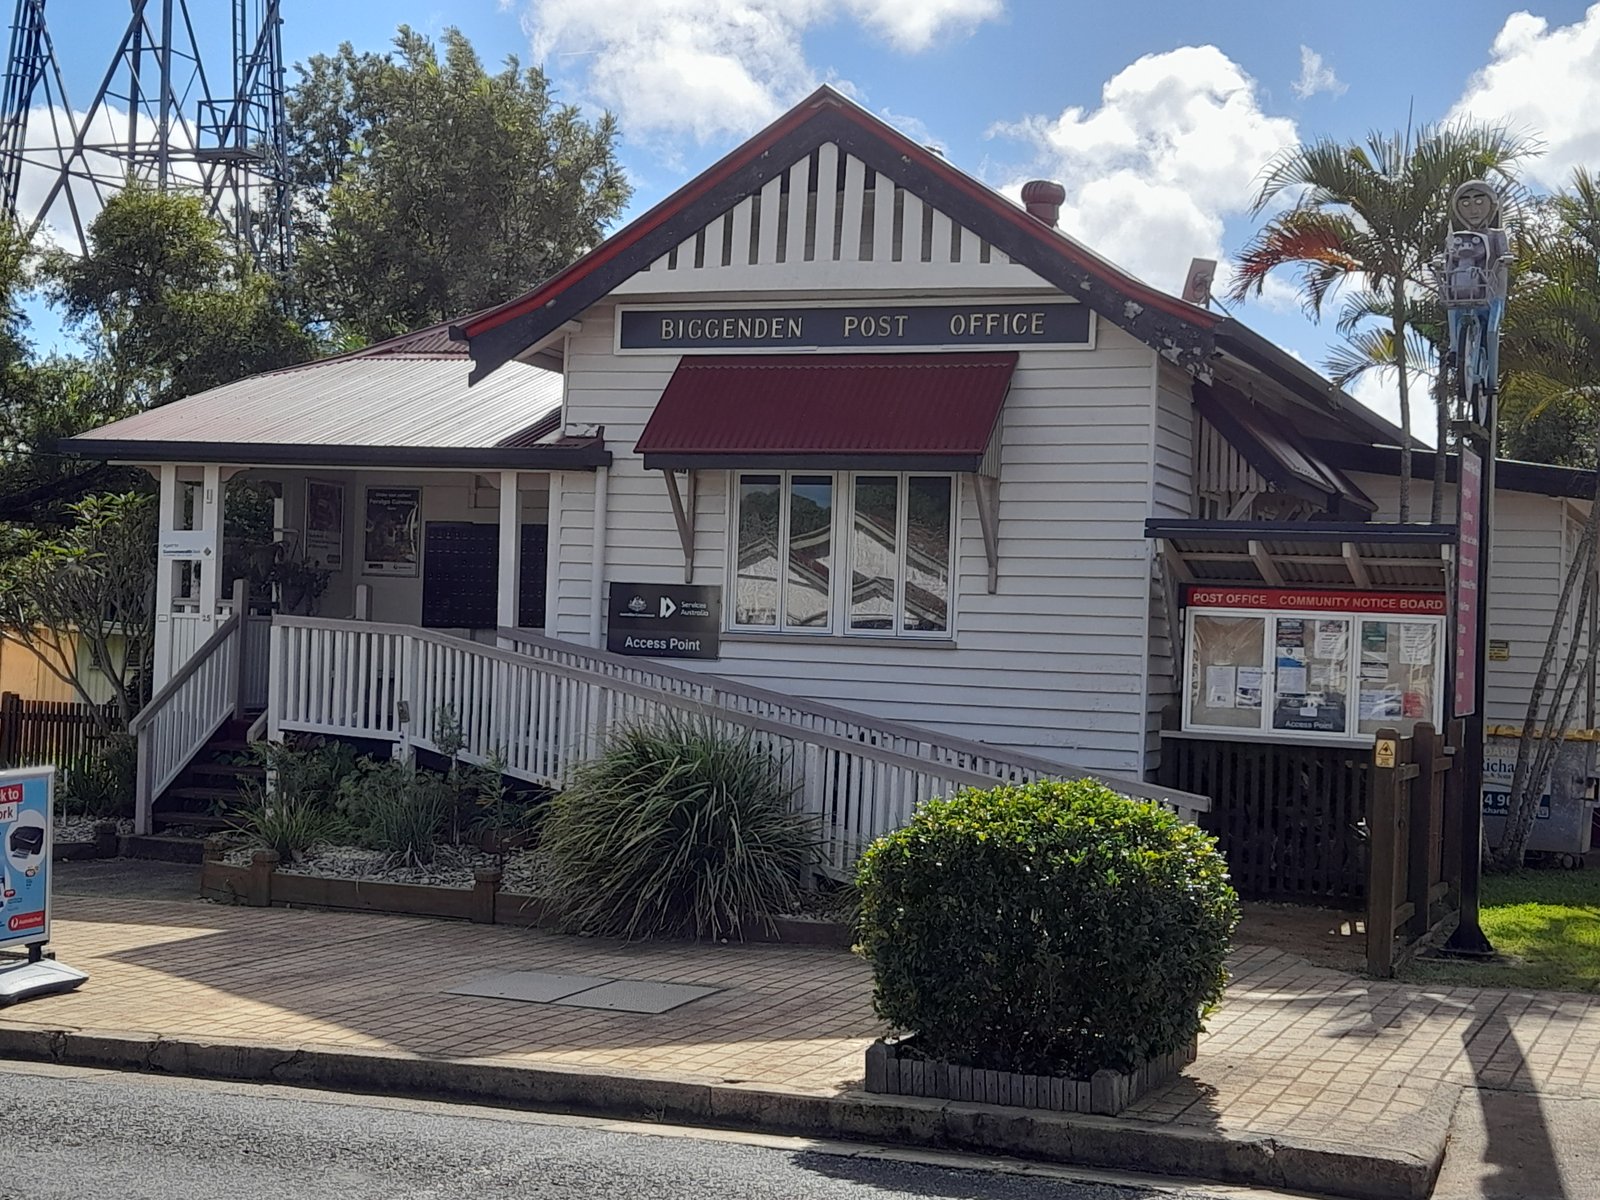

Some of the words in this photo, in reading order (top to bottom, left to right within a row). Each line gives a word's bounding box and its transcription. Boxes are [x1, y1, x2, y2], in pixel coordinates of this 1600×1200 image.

[660, 316, 803, 340] BIGGENDEN
[843, 315, 909, 338] POST
[949, 312, 1045, 336] OFFICE
[1193, 593, 1223, 603] POST
[1226, 594, 1267, 605] OFFICE
[1279, 595, 1350, 607] COMMUNITY
[1352, 598, 1396, 609] NOTICE
[1400, 599, 1443, 610] BOARD
[625, 636, 666, 649] Access
[670, 638, 700, 651] Point
[8, 787, 20, 801] to
[0, 805, 14, 820] ork
